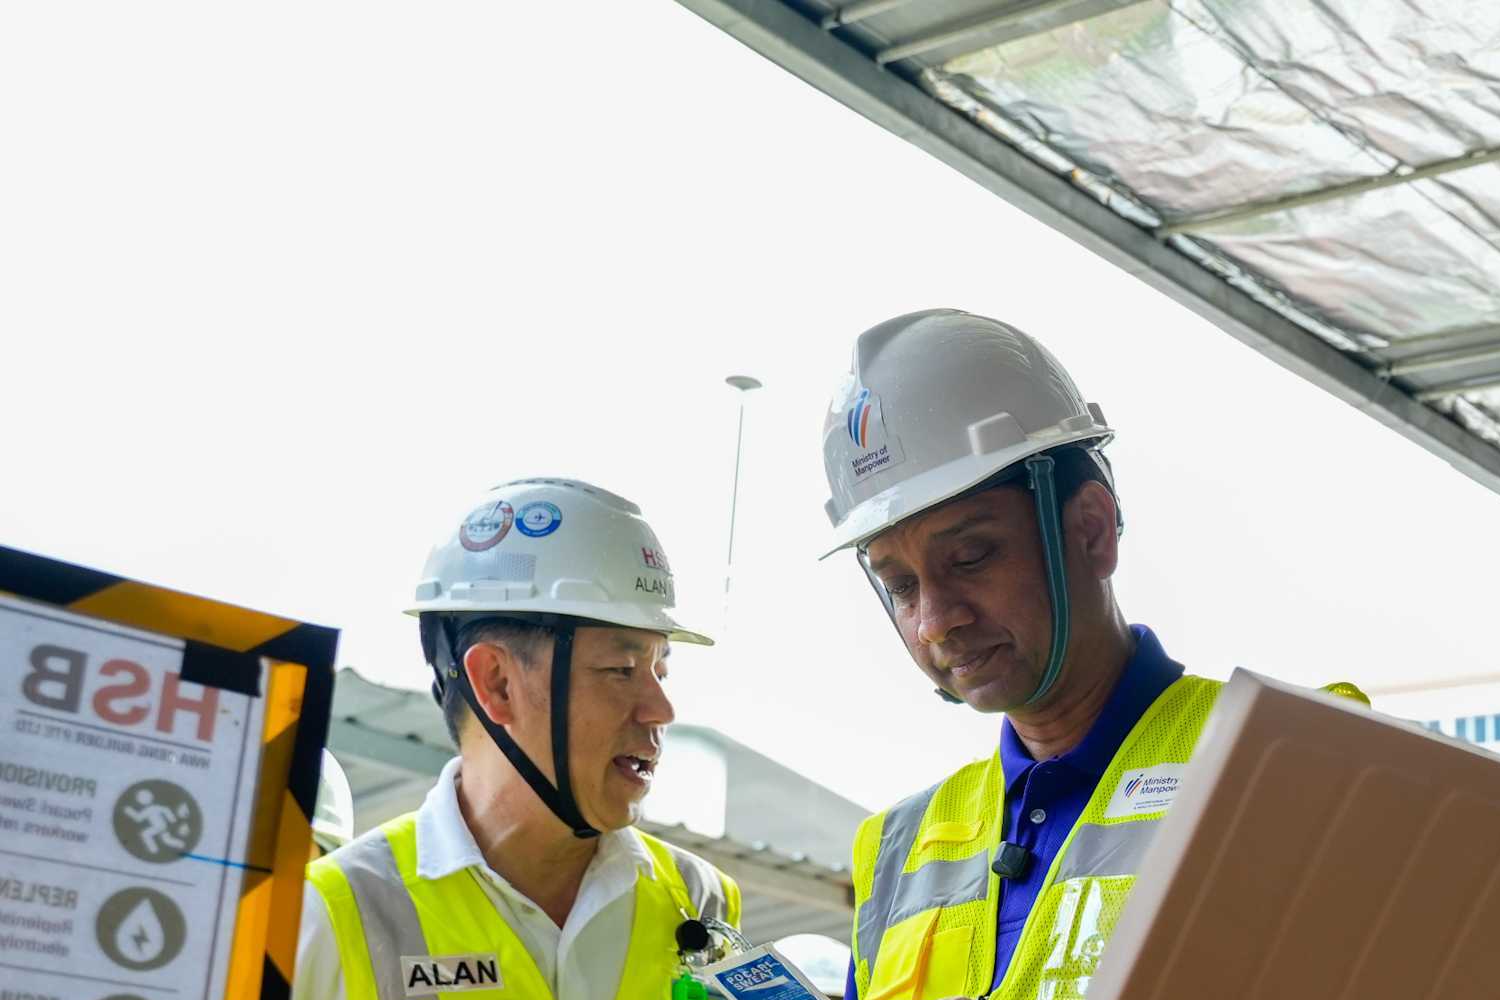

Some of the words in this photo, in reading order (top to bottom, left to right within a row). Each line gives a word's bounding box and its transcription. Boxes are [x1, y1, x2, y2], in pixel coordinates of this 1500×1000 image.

[852, 450, 878, 469] Ministry
[854, 455, 890, 477] Manpower
[1142, 776, 1178, 786] Ministry
[408, 960, 498, 987] ALAN
[726, 960, 775, 985] POCARI
[734, 969, 775, 991] SWEAT
